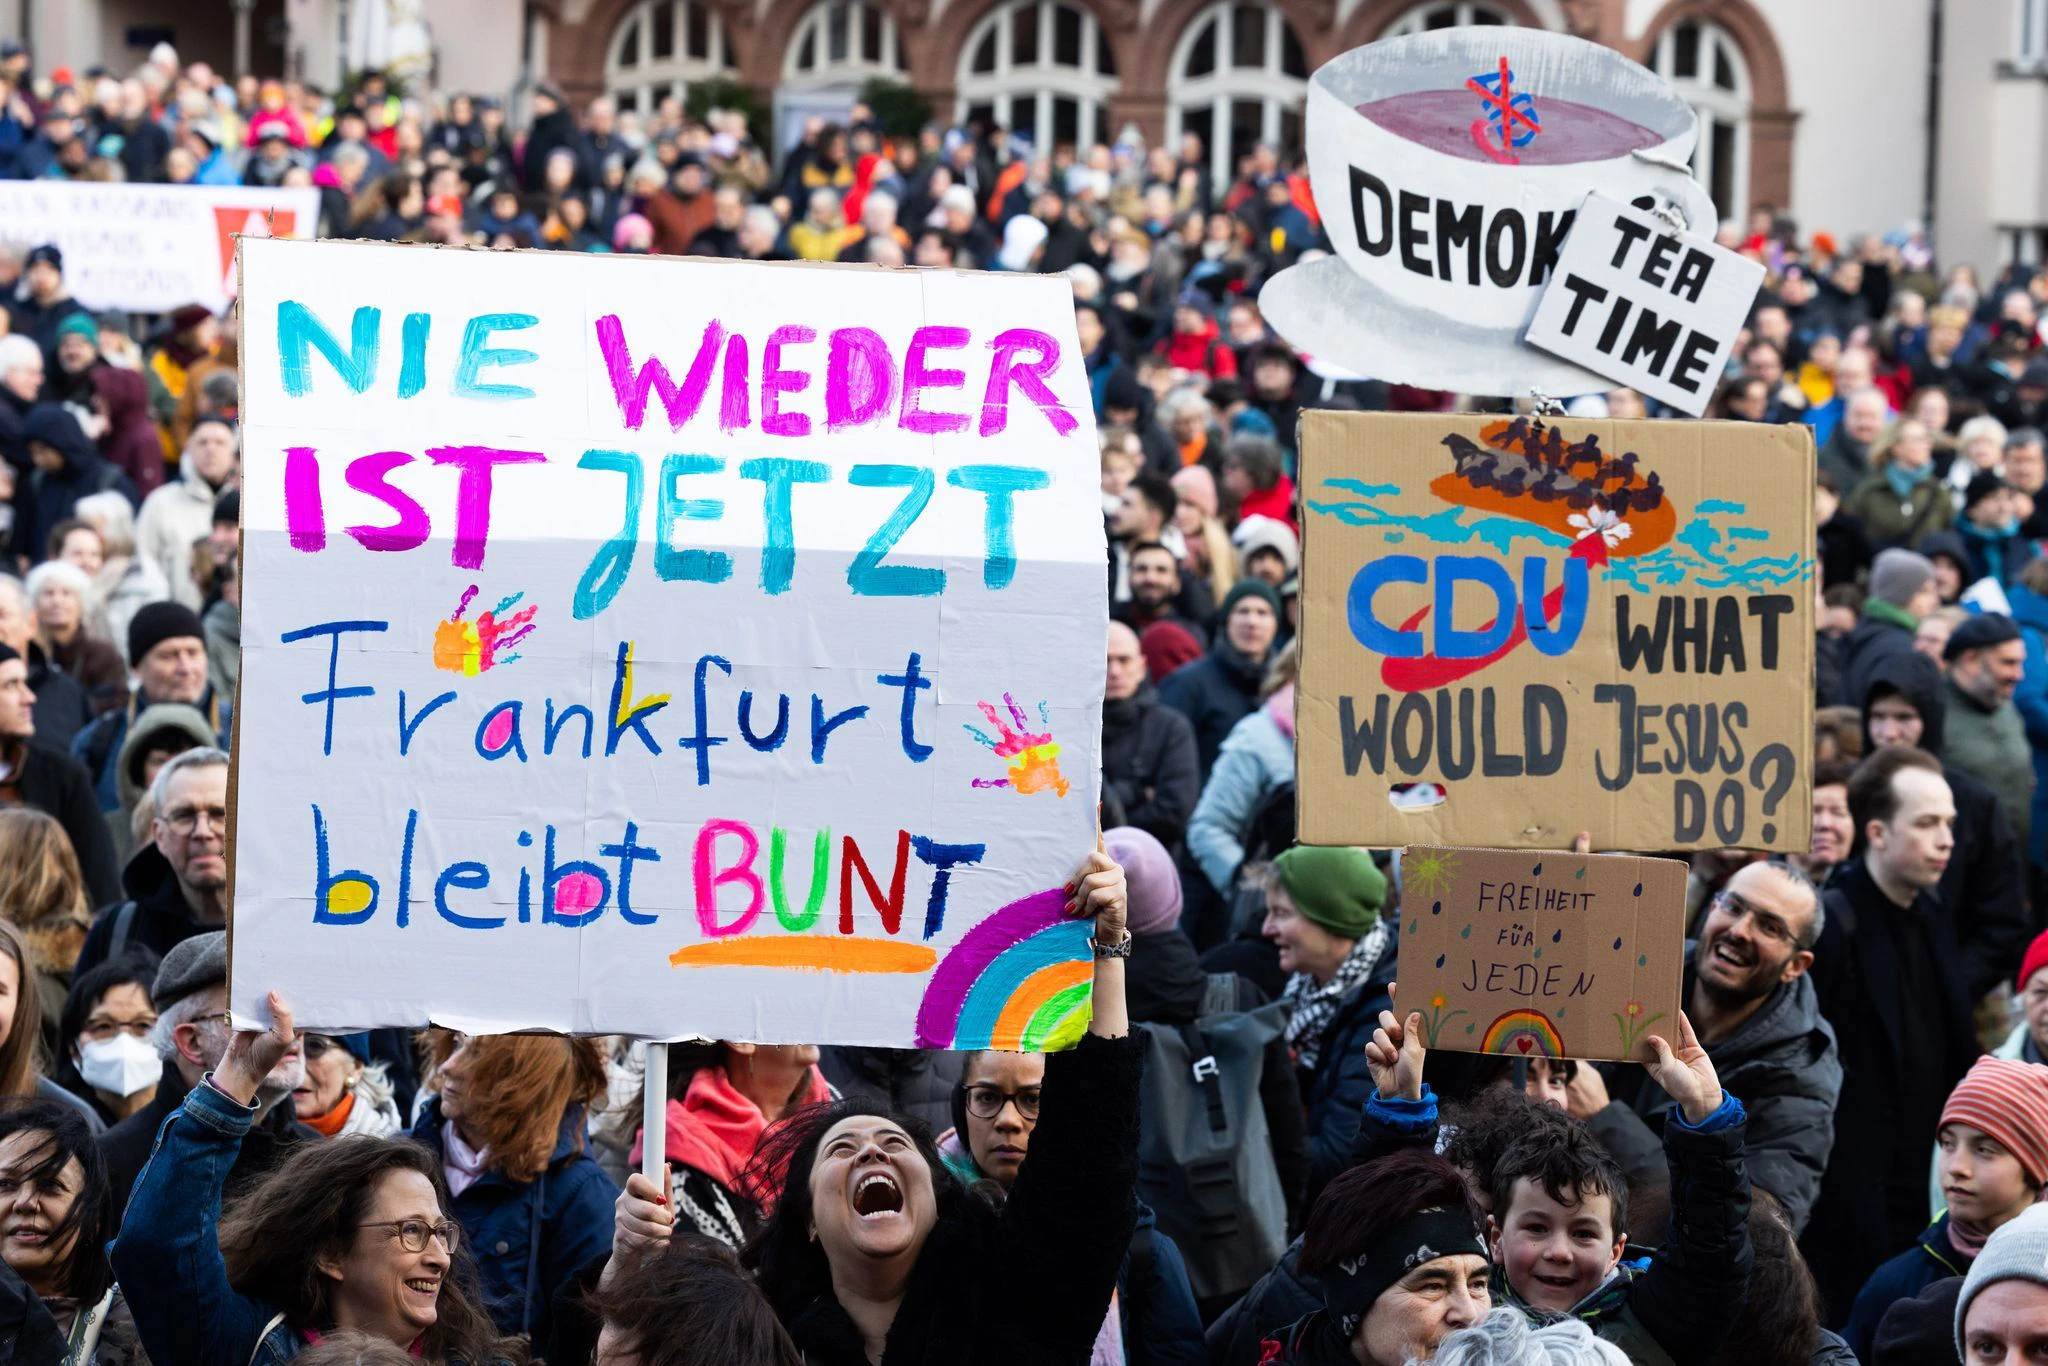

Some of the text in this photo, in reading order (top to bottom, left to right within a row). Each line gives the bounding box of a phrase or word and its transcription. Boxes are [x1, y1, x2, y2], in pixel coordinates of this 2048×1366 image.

[1347, 164, 1579, 289] DEMOK
[1610, 214, 1715, 303] TEA
[276, 299, 1080, 437] NIE WIEDER
[1561, 272, 1720, 395] TIME
[282, 444, 1053, 622] IST JETZT
[1346, 555, 1795, 676] CDU WHAT
[281, 620, 935, 787] Frankfurt
[1338, 683, 1748, 792] WOULD JESUS
[1674, 743, 1796, 845] DO?
[312, 803, 987, 942] bleibt BUNT
[1478, 881, 1596, 912] FREIHEIT
[1462, 959, 1596, 998] JEDEN
[1496, 923, 1535, 947] FÜR
